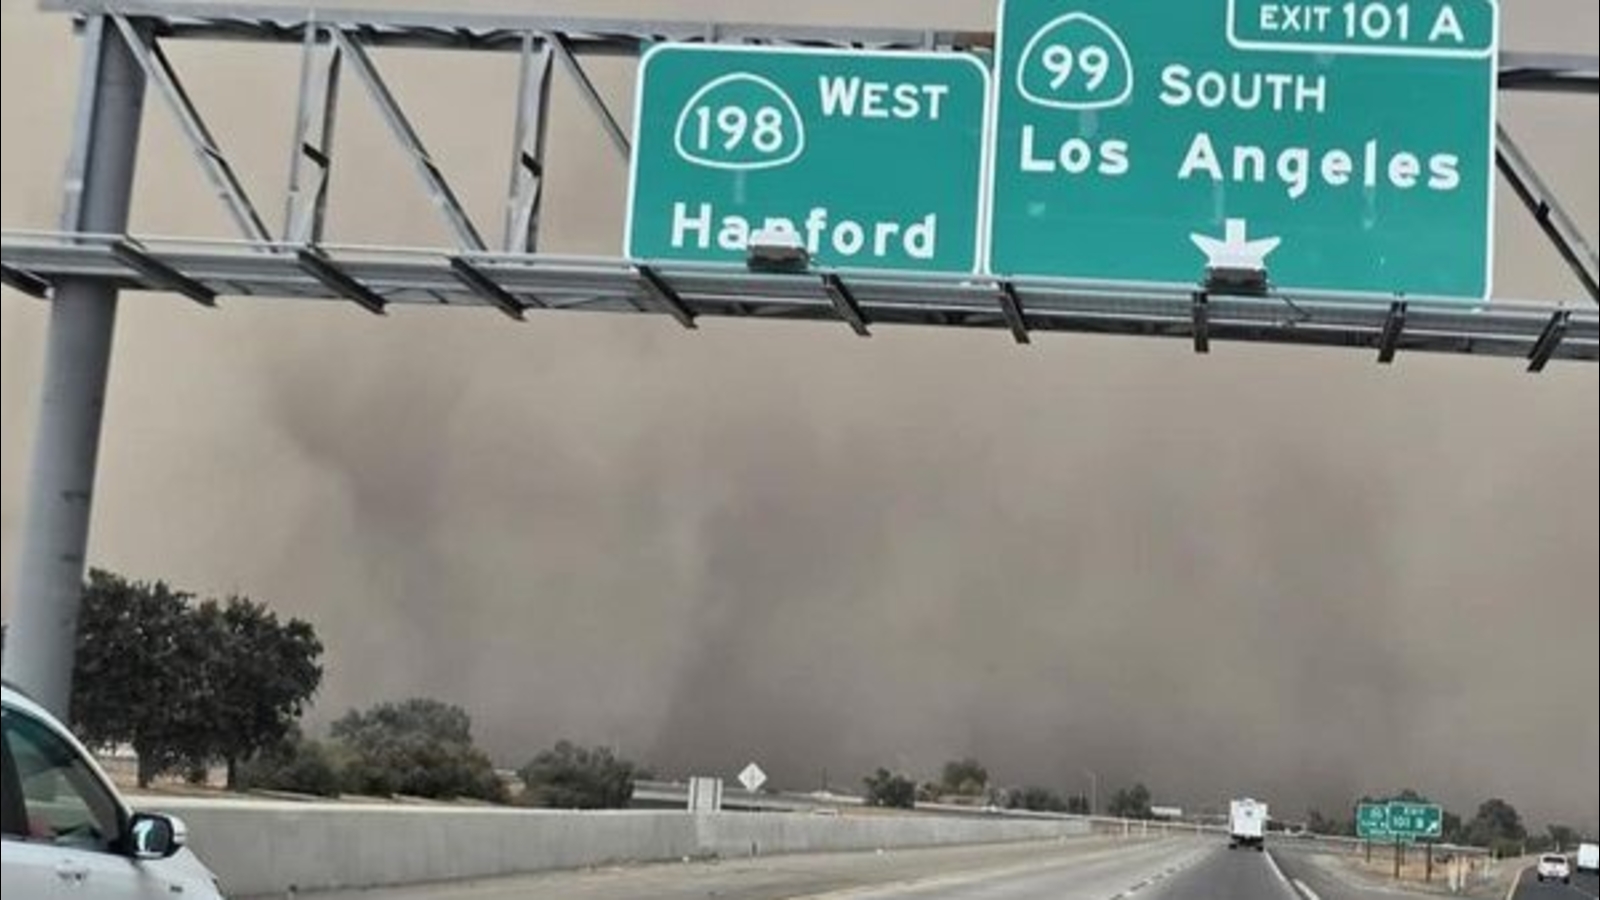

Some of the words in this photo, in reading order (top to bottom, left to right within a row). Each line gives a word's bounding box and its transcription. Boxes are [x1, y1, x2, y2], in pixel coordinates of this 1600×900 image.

[1260, 4, 1331, 32] EXIT
[1343, 2, 1408, 40] 101
[1428, 5, 1464, 42] A
[1042, 45, 1109, 92] 99
[1158, 64, 1326, 112] SOUTH
[818, 75, 948, 120] WEST
[696, 105, 783, 152] 198
[1020, 125, 1129, 175] Los
[1178, 132, 1460, 198] Angeles
